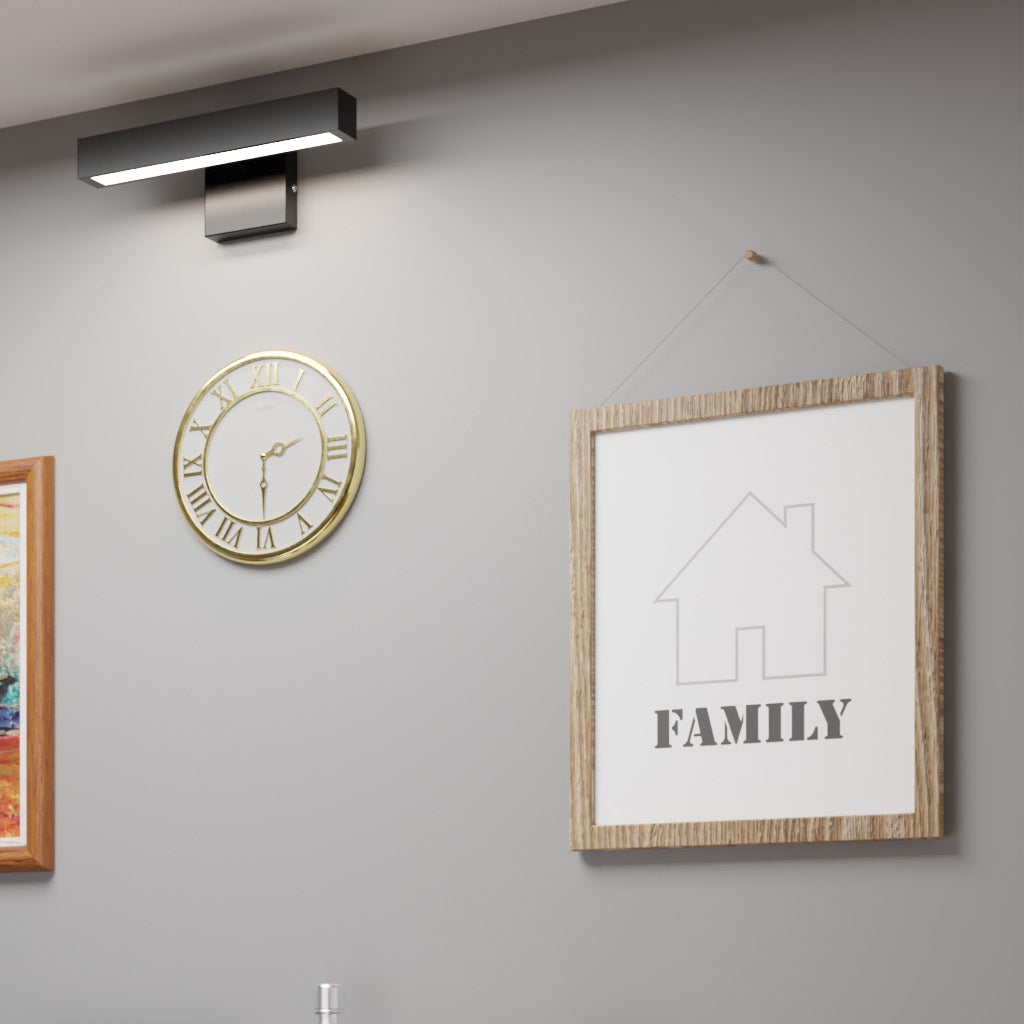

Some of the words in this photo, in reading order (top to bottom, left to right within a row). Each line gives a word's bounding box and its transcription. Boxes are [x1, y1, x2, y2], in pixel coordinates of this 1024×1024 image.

[250, 361, 280, 388] XII
[291, 368, 306, 392] I
[210, 378, 239, 410] XI
[315, 392, 338, 416] II
[189, 419, 213, 439] X
[327, 434, 348, 461] III
[183, 453, 203, 478] IX
[317, 473, 342, 503] IV
[186, 483, 216, 526] VIII
[215, 516, 243, 549] VII
[255, 525, 276, 550] VI
[296, 512, 314, 536] V
[654, 698, 852, 749] FAMILY
